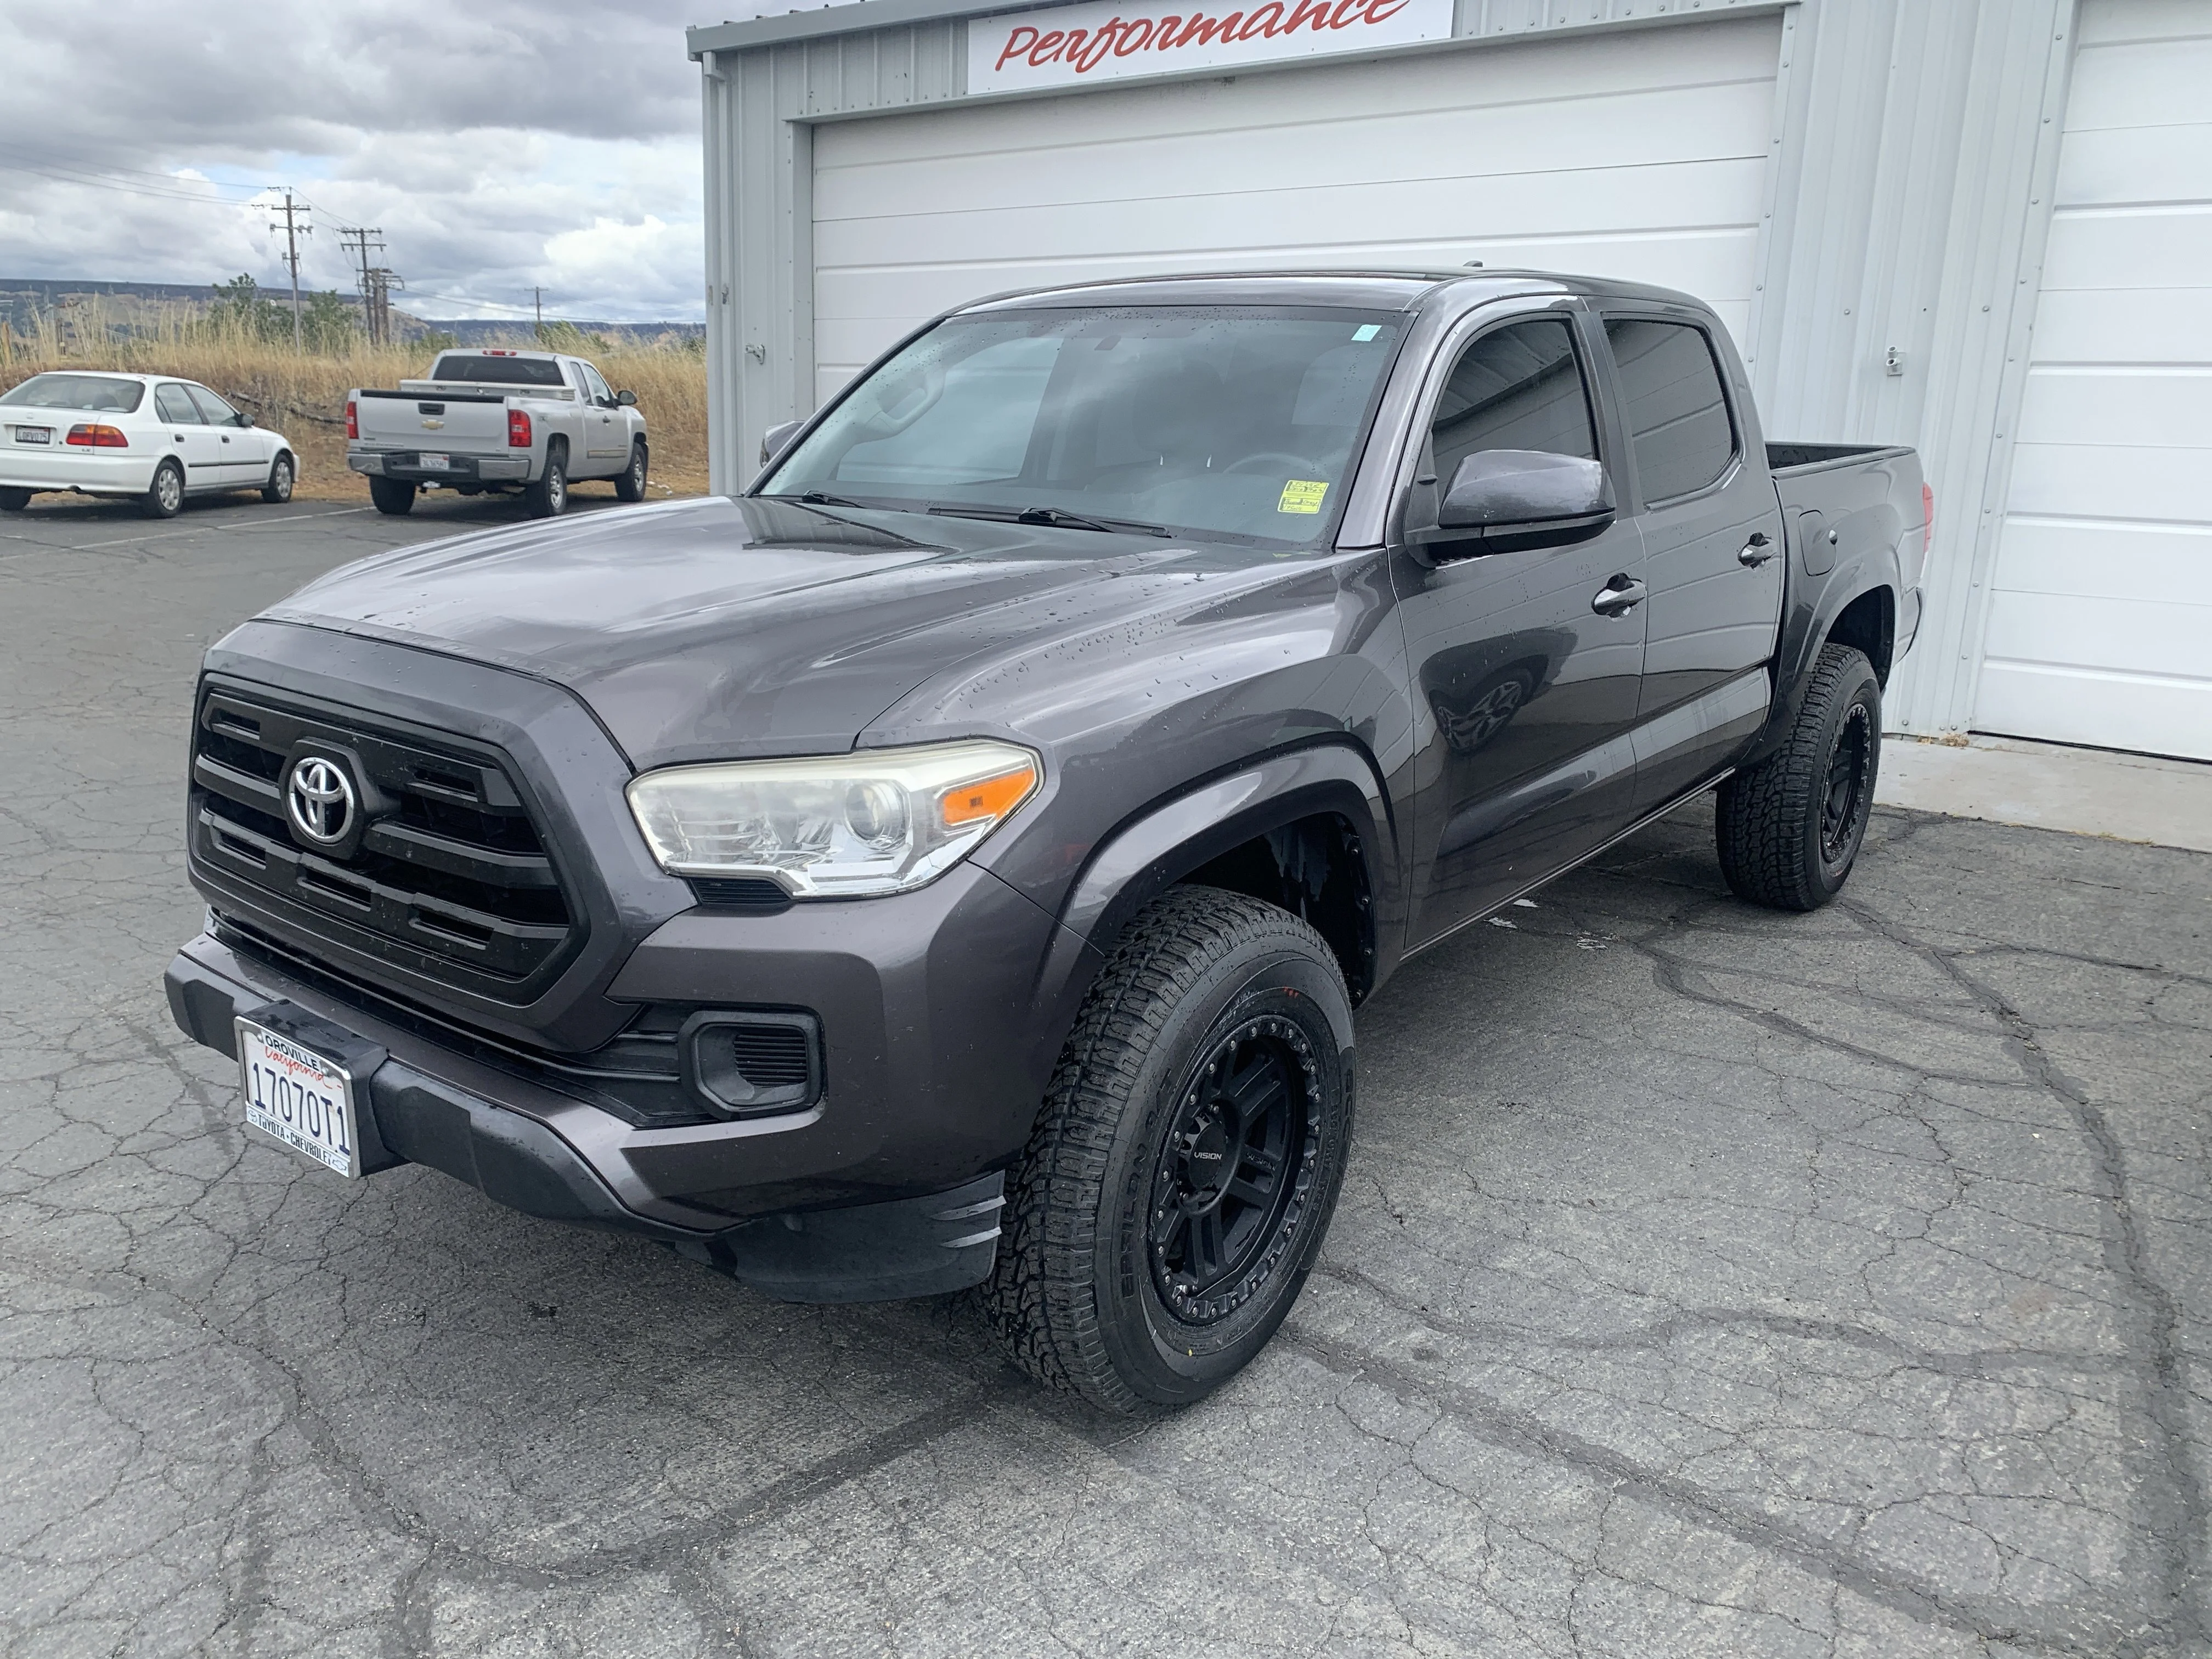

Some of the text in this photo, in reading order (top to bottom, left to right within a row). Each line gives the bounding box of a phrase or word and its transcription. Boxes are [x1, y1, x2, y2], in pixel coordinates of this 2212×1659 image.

[995, 0, 1410, 74] Performance
[265, 1035, 320, 1071] OROVILLE
[253, 1062, 349, 1156] 17070T1
[258, 1114, 286, 1140] TOYOTA
[1194, 1152, 1222, 1160] VISION
